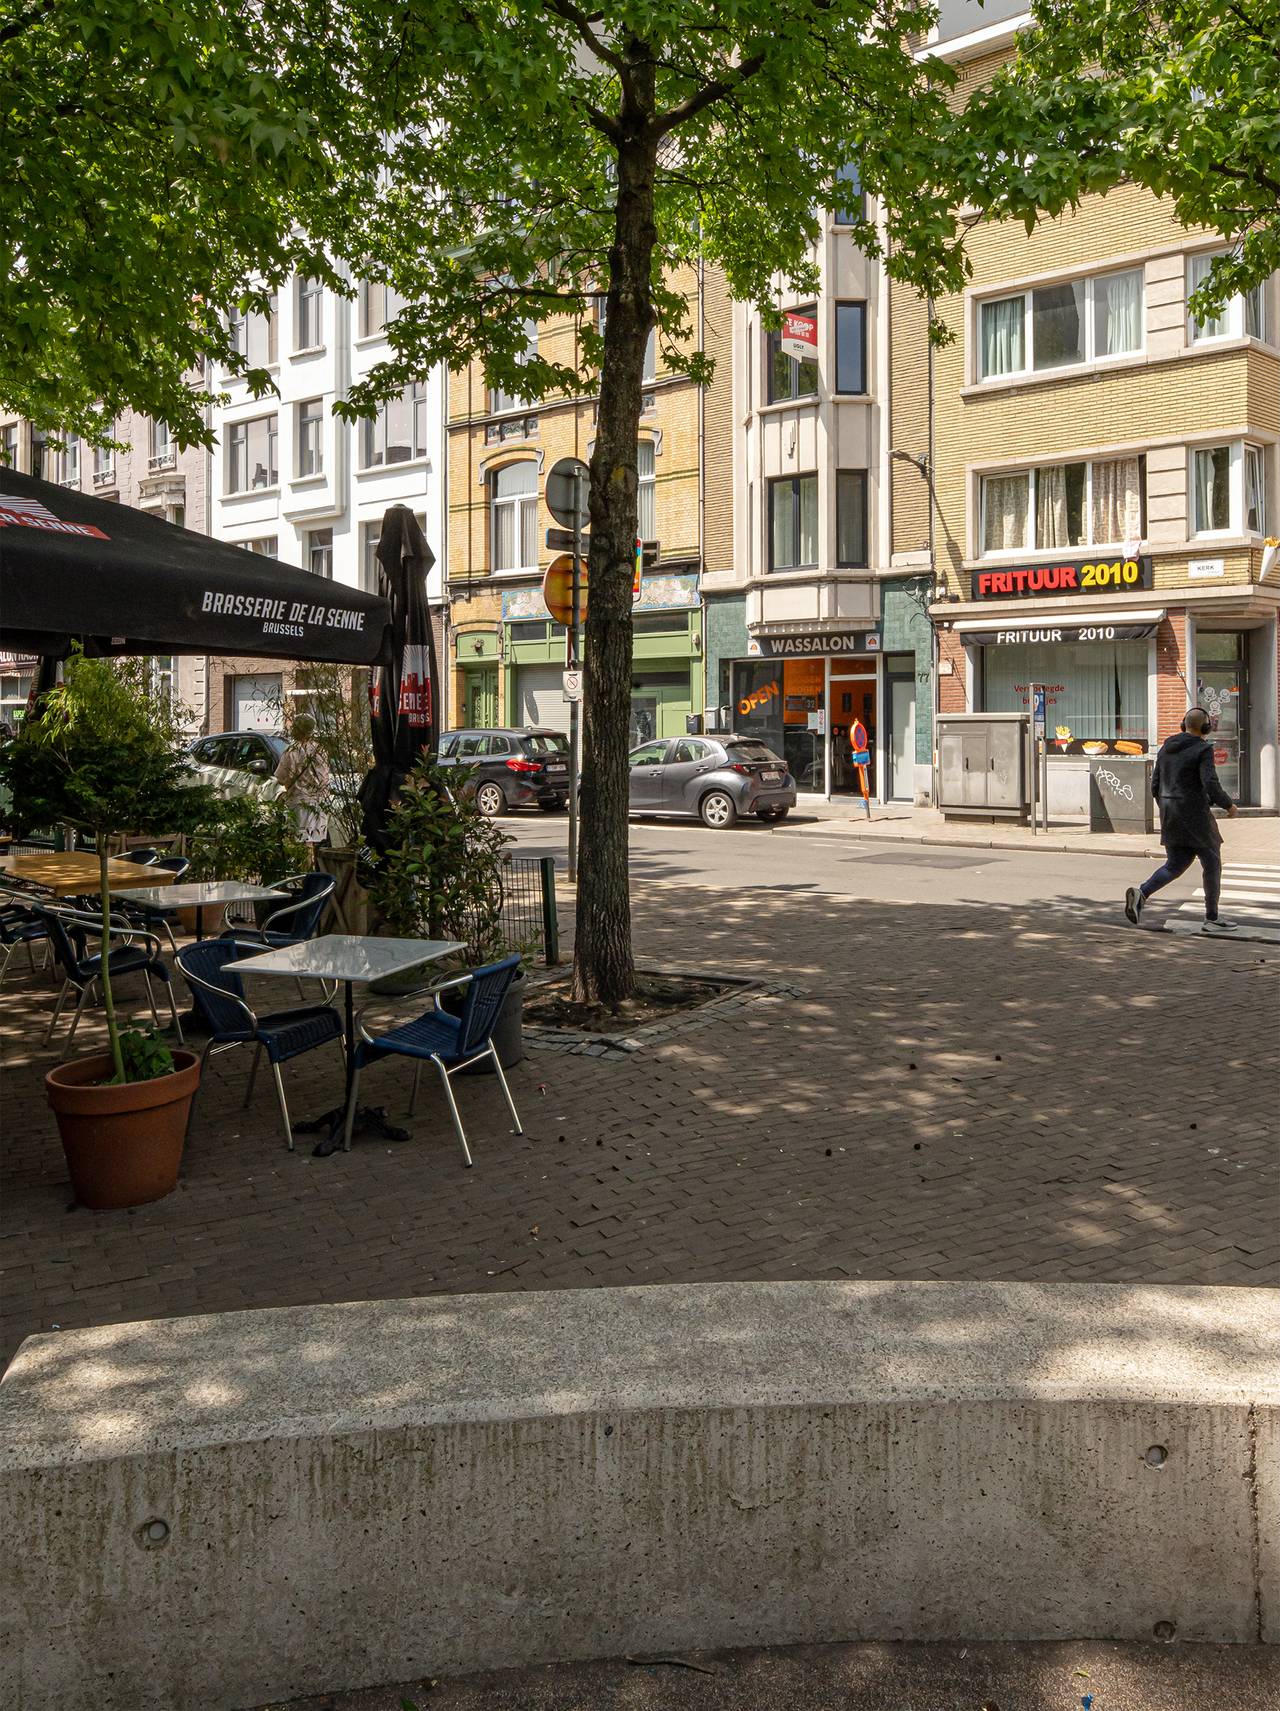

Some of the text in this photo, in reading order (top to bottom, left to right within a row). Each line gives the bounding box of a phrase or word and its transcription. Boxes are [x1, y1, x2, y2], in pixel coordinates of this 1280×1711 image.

[21, 517, 94, 536] SENNE
[978, 561, 1139, 594] FRITUUR 2010
[202, 591, 366, 631] BRASSERIE DE LA SENNE
[262, 621, 304, 637] BRUSSELS
[997, 627, 1115, 644] FRITUUR 2010
[771, 636, 855, 653] WASSALON
[917, 672, 930, 683] 77
[738, 680, 780, 715] OPEN
